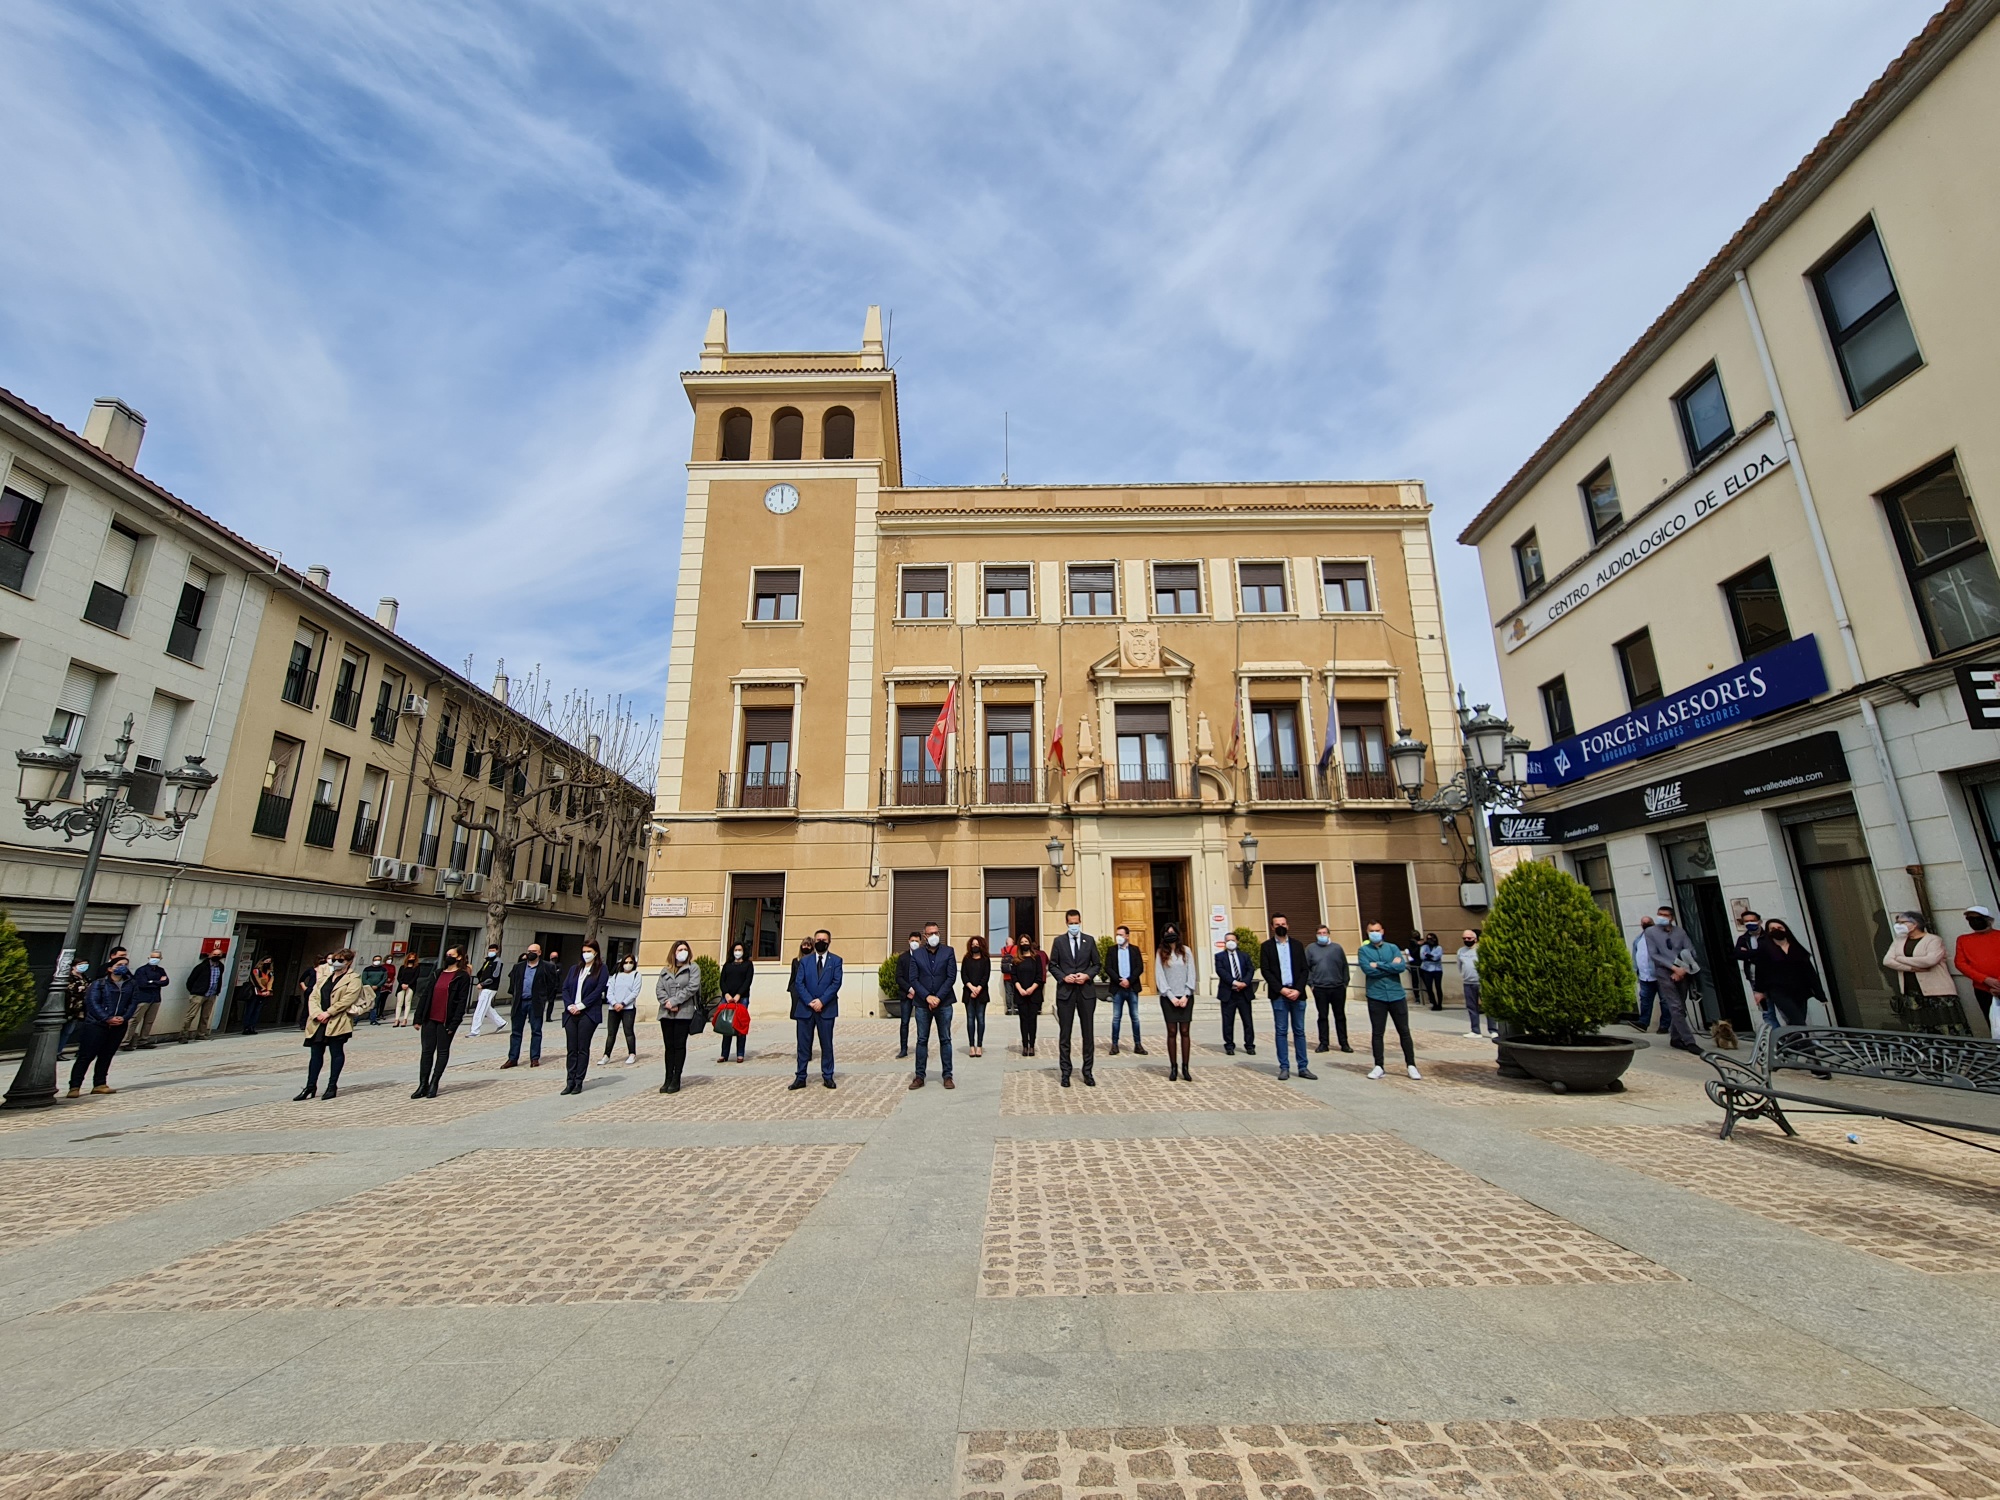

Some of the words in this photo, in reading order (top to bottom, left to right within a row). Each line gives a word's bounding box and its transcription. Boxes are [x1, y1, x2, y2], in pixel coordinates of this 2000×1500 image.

[1548, 583, 1590, 620] CENTRO
[1596, 514, 1686, 587] AUDIOLOGICO
[1694, 490, 1718, 517] DE
[1724, 453, 1775, 497] ELDA
[1580, 716, 1650, 763] FORCÉN
[1656, 666, 1767, 731] ASESORES
[1601, 743, 1637, 763] ABOGADOS
[1645, 725, 1684, 748] ASESORES
[1694, 703, 1741, 729] GESTORES
[1651, 781, 1682, 812] VALLE
[1743, 771, 1824, 796] www.valledeelda.com
[1510, 818, 1546, 838] VALLE
